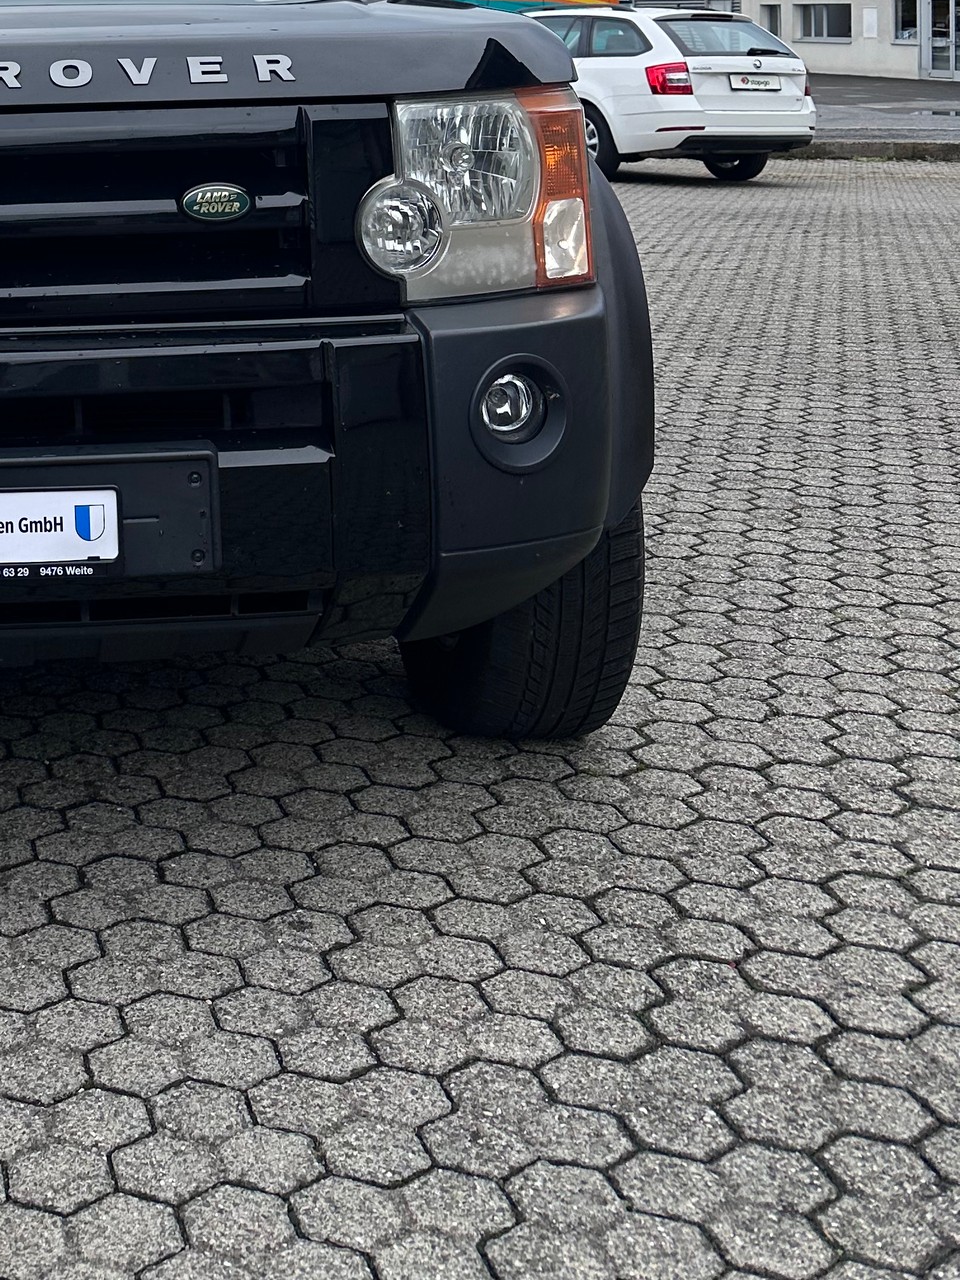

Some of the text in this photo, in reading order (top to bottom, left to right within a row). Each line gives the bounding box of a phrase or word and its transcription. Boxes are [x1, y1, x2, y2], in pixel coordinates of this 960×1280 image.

[196, 192, 229, 202] LAND
[200, 202, 240, 213] ROVER
[18, 516, 64, 533] GmbH
[3, 568, 15, 578] 63
[17, 567, 29, 577] 29
[39, 566, 64, 576] 9476
[65, 566, 93, 576] Weite
